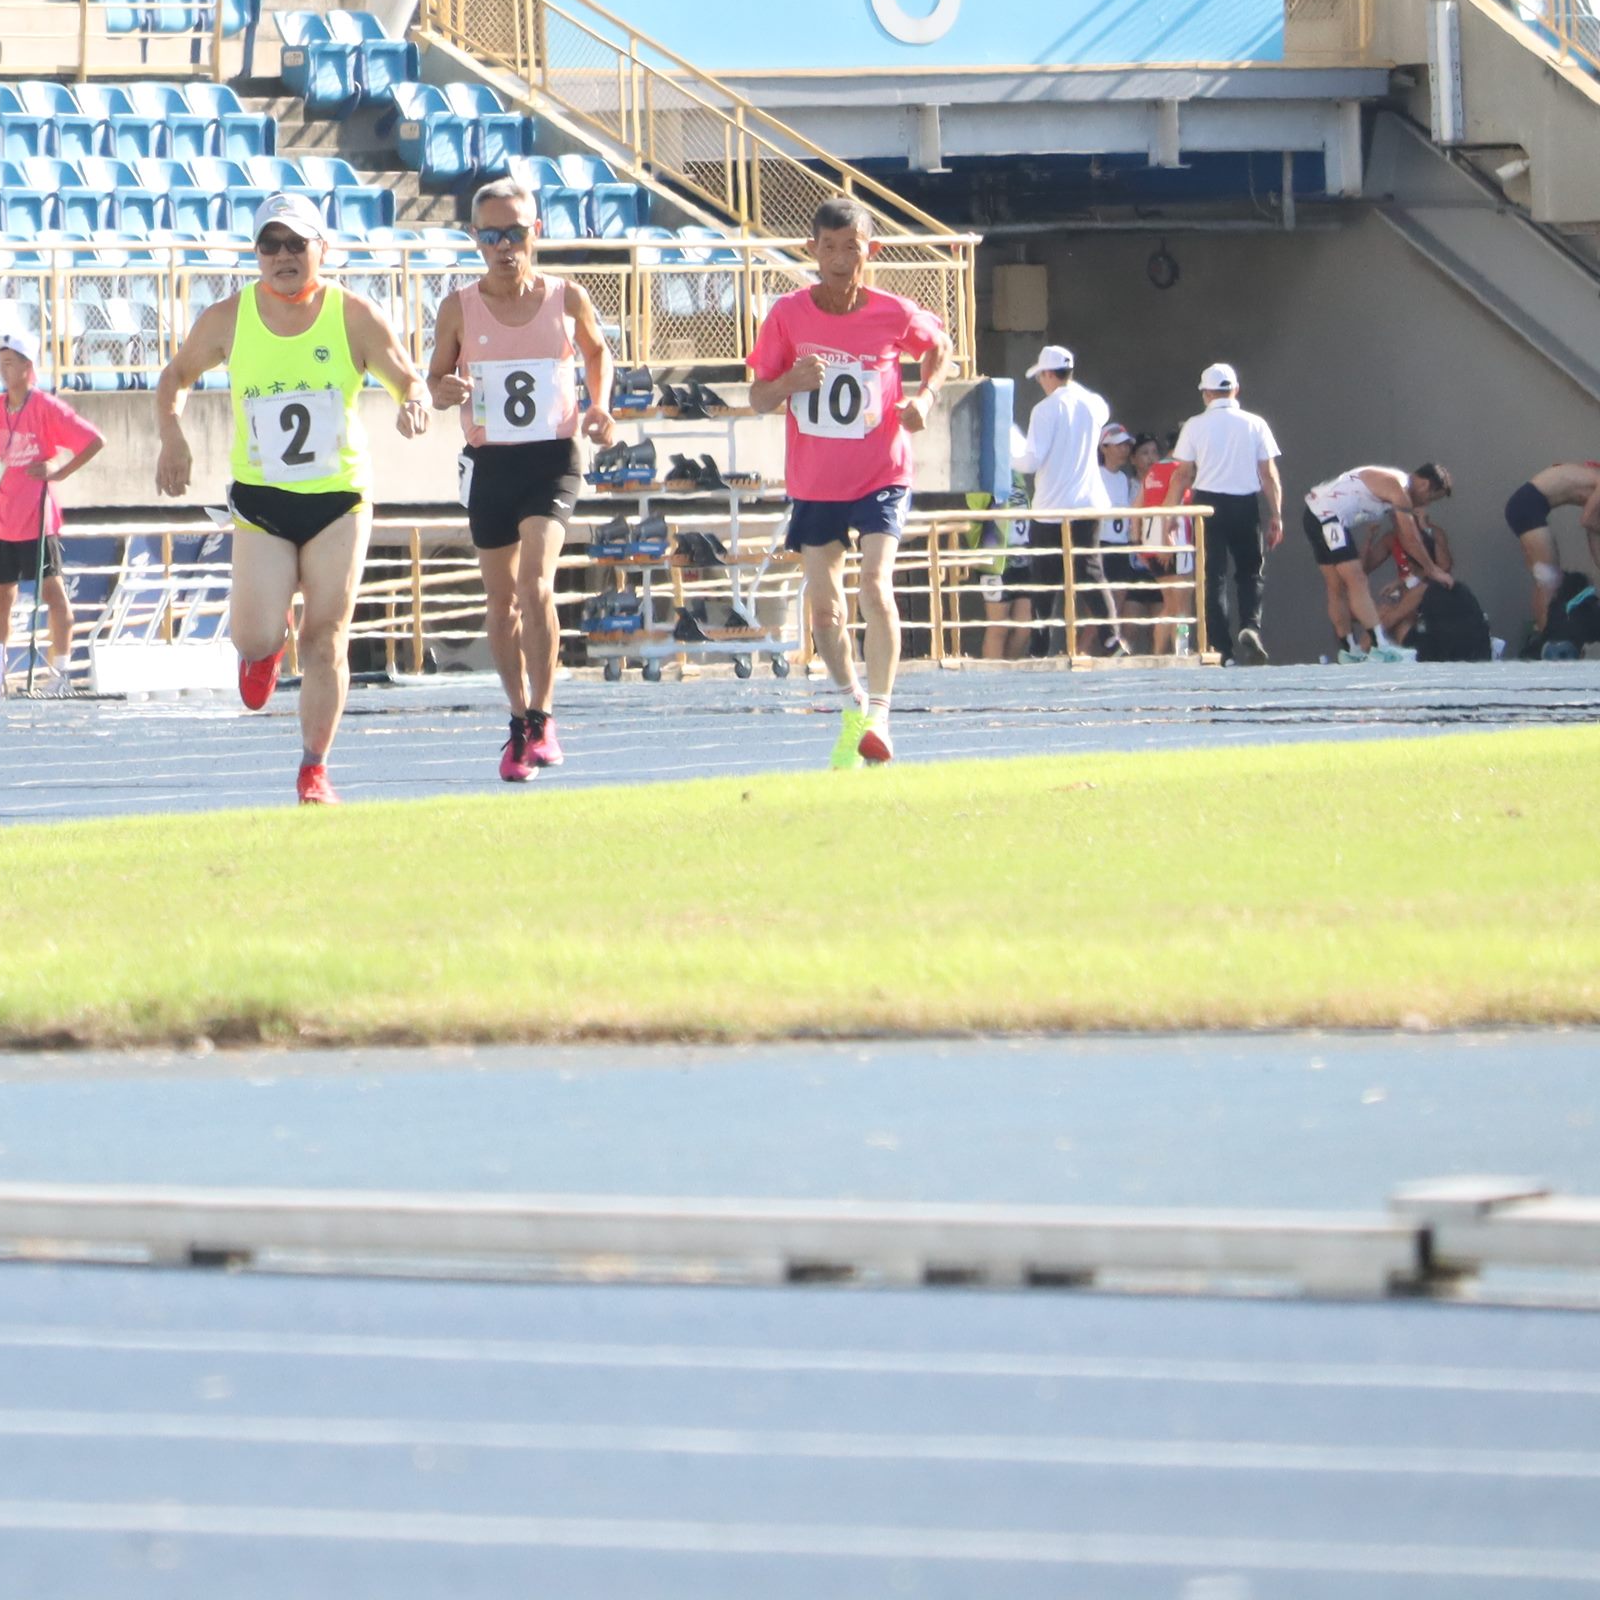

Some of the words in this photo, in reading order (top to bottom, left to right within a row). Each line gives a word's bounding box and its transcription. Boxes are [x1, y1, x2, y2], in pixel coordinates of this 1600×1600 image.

[504, 370, 536, 428] 8
[808, 373, 862, 426] 10
[280, 403, 315, 466] 2
